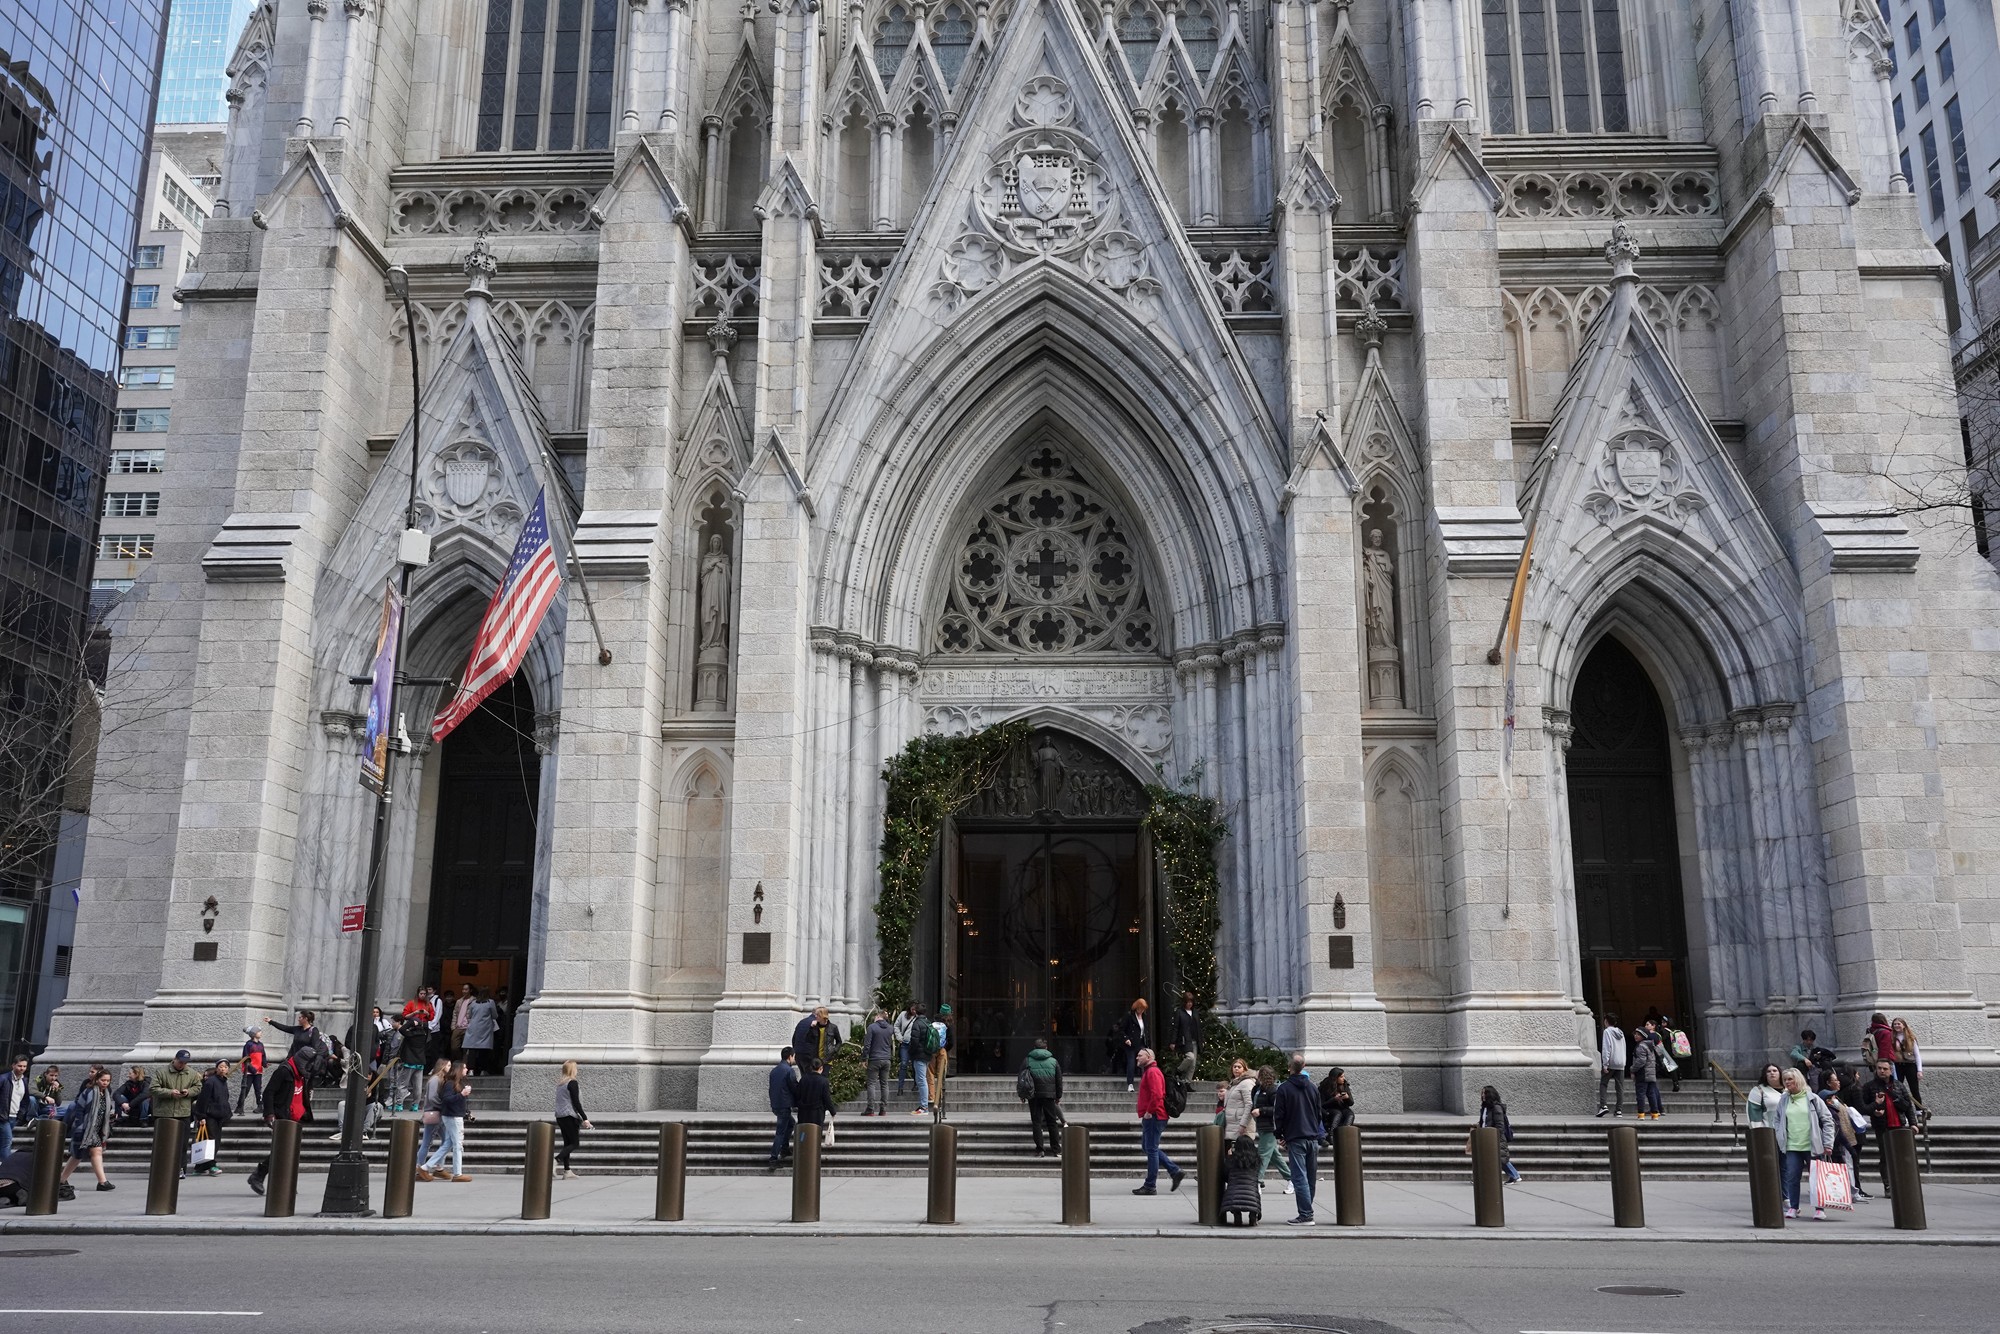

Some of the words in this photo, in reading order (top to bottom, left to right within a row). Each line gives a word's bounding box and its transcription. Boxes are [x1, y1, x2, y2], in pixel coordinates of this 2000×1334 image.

[946, 671, 986, 684] Spiritus
[988, 671, 1030, 683] Sanctus
[946, 684, 971, 697] quem
